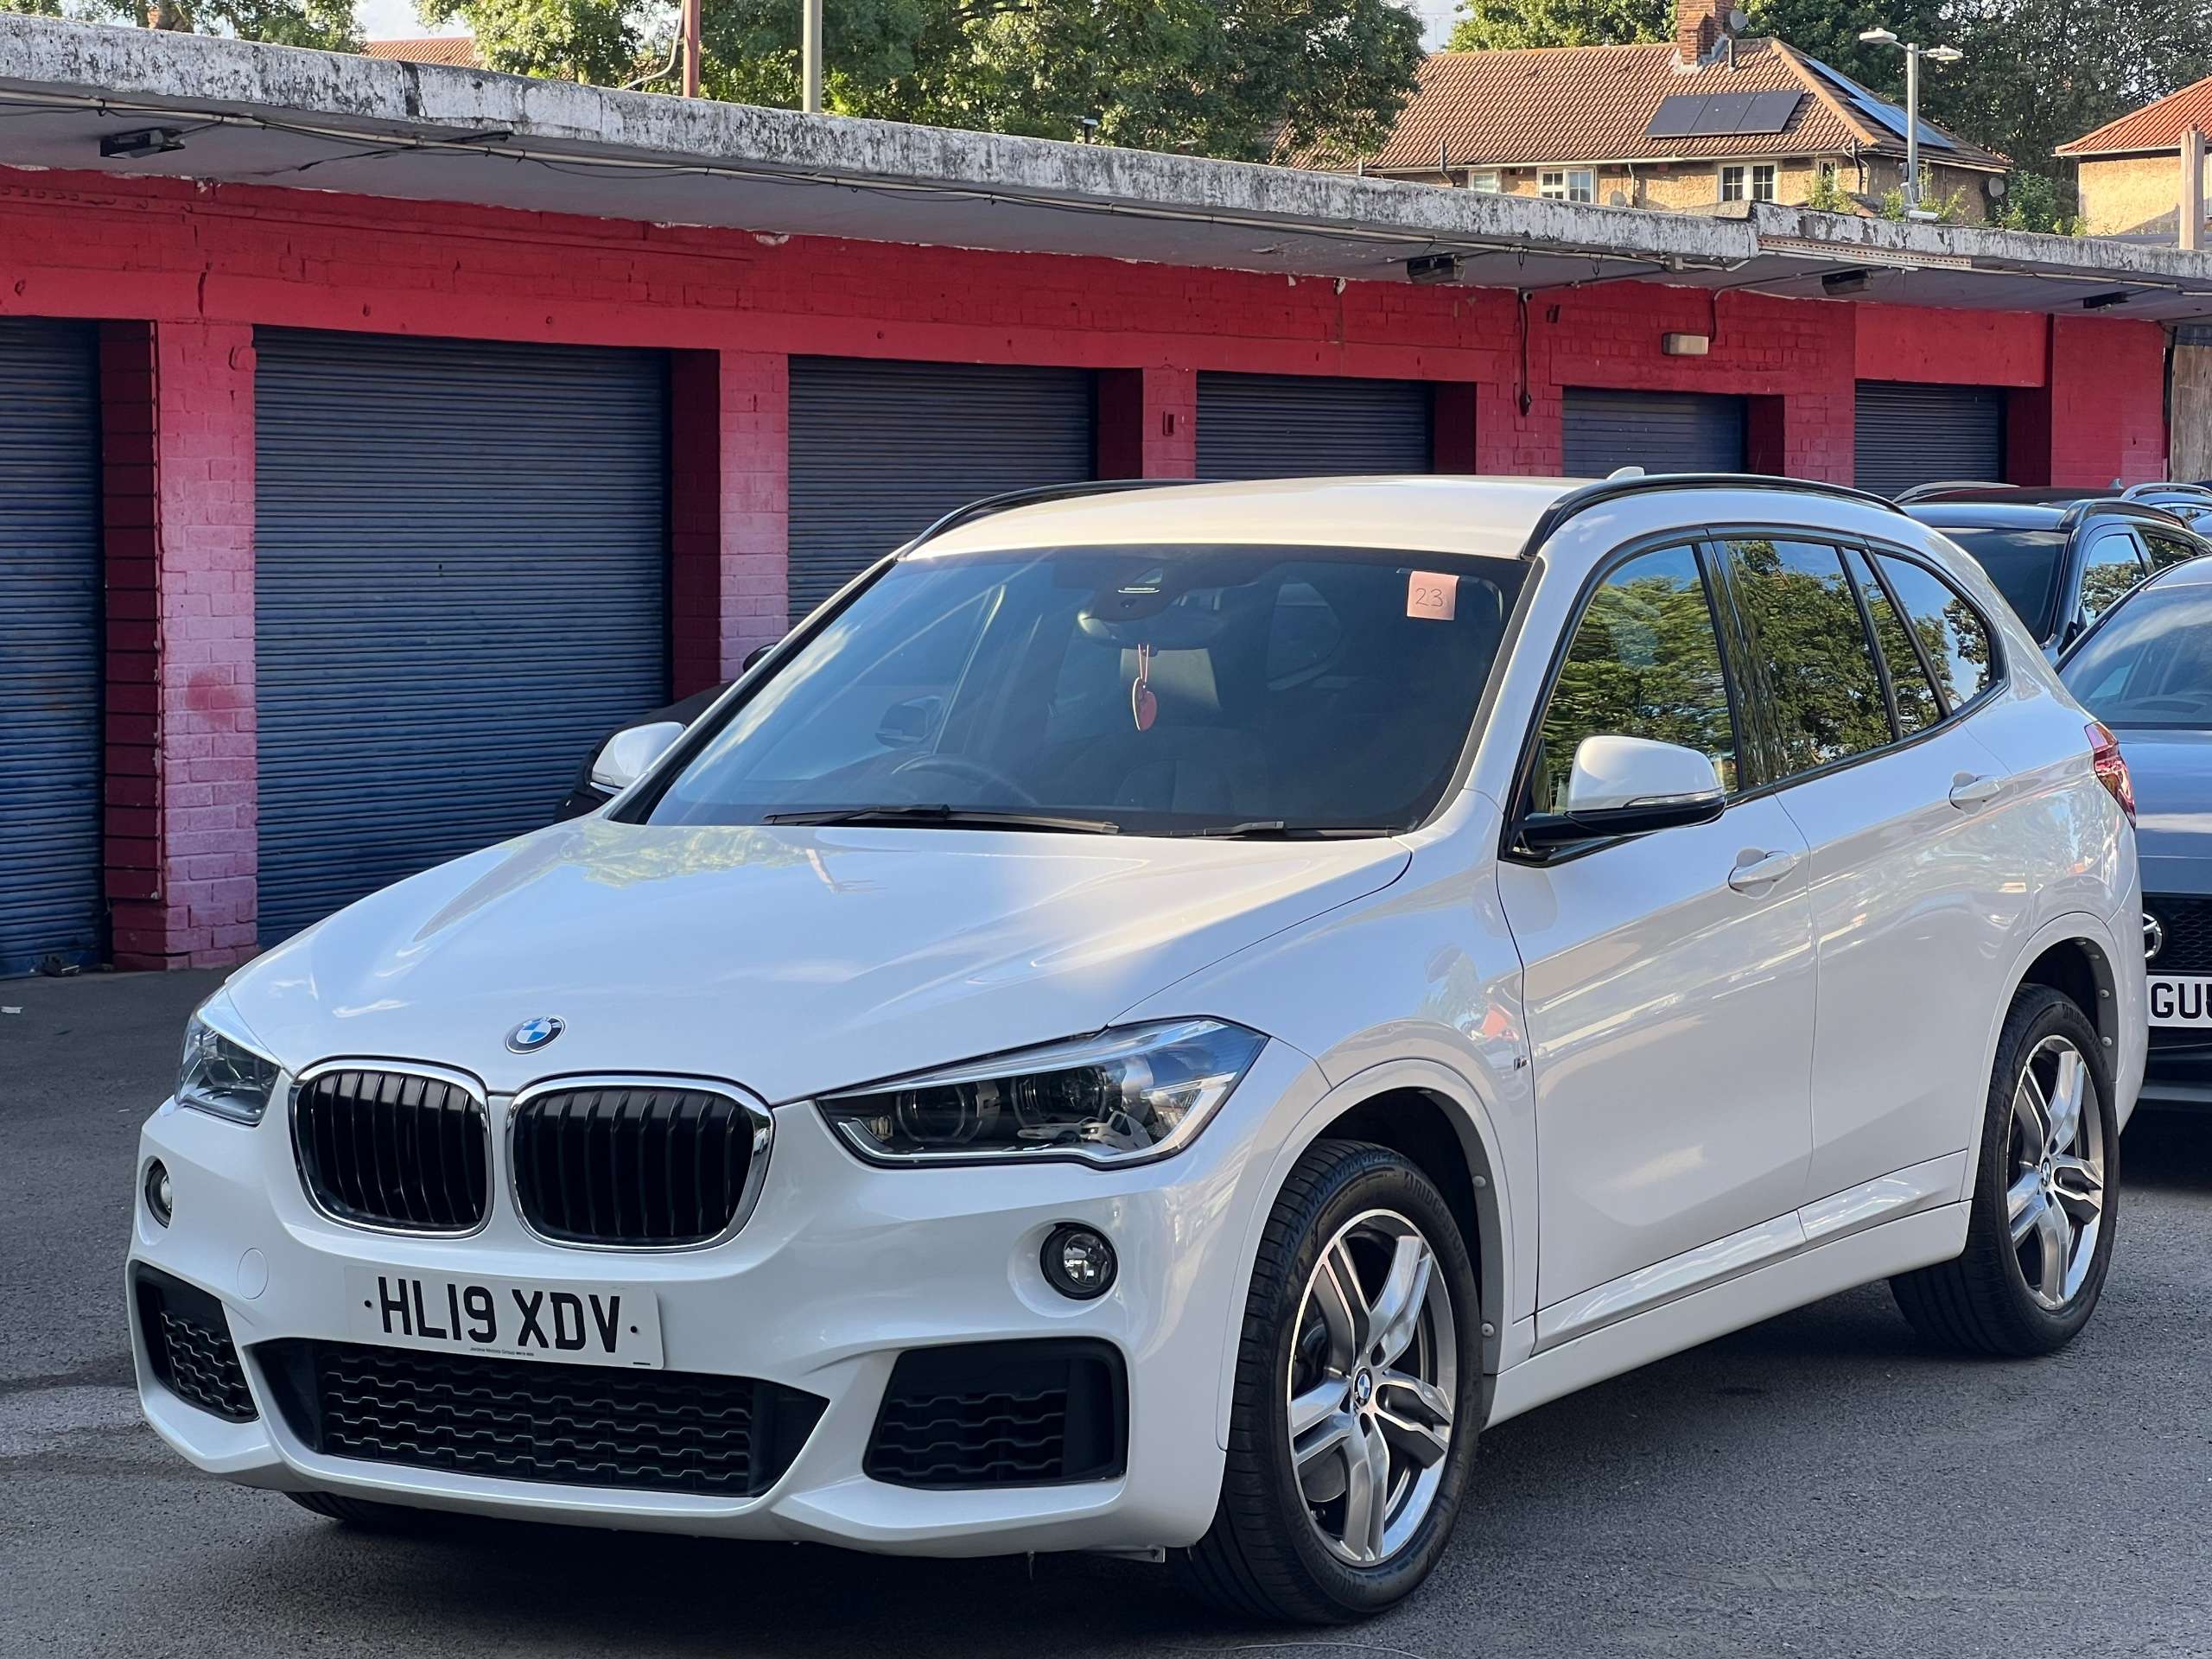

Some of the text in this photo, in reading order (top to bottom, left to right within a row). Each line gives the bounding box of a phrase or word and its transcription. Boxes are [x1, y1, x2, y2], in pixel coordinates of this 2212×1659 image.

[1415, 588, 1444, 607] 23
[2151, 982, 2212, 1020] GU
[378, 1276, 620, 1353] HL19 XDV
